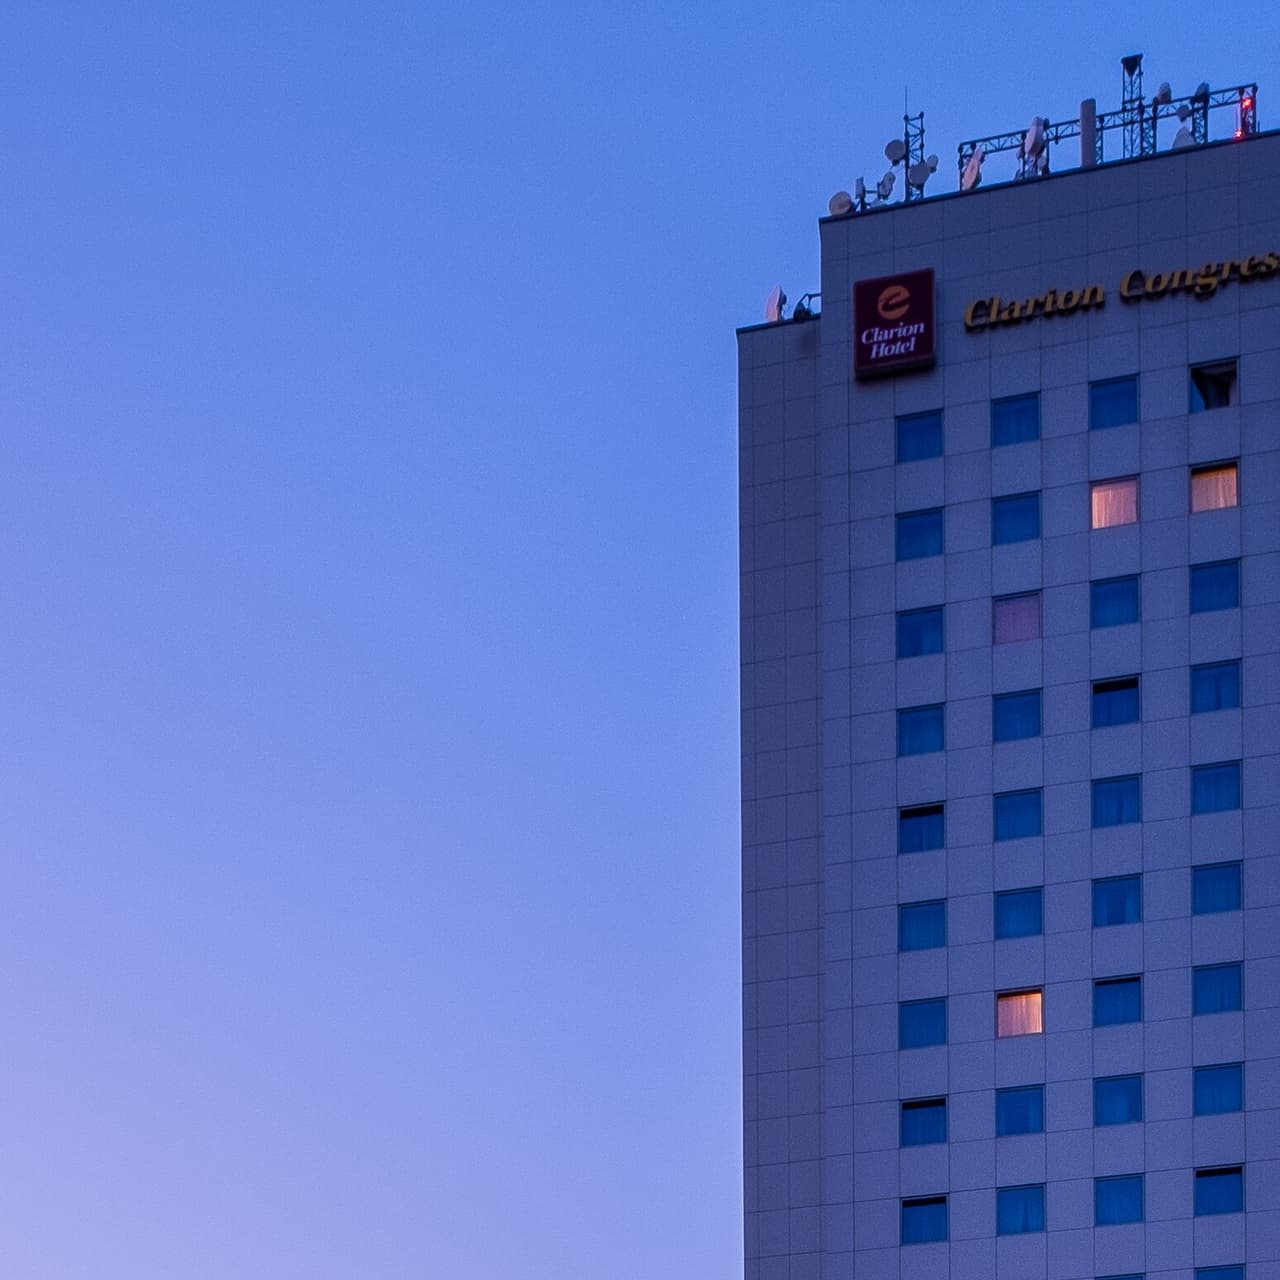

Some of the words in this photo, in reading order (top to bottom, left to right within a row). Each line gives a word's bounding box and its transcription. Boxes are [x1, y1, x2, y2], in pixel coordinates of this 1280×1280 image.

[963, 283, 1106, 330] Clarion
[861, 322, 924, 345] Clarion
[870, 337, 916, 359] Hotel
